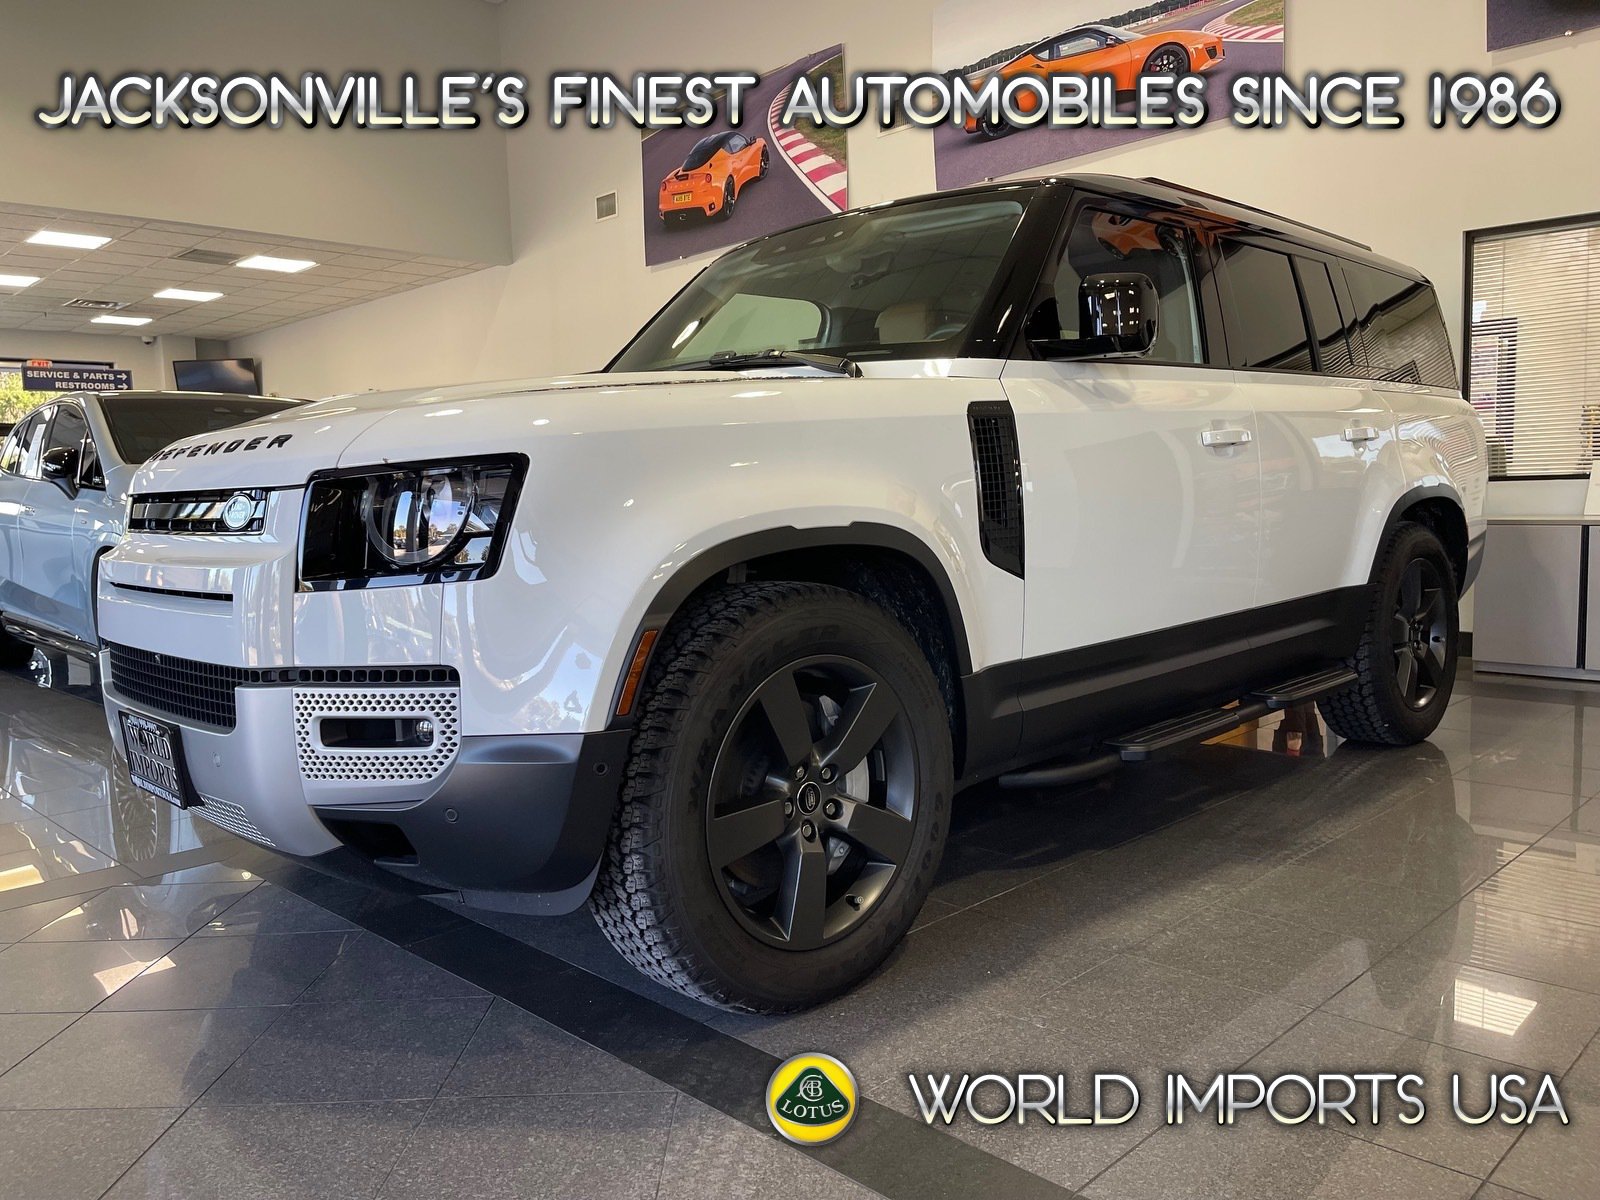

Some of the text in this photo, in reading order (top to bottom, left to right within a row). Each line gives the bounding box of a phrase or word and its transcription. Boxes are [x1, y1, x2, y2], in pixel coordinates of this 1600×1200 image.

[26, 370, 115, 380] SERVICE & PARTS
[55, 381, 116, 390] RESTROOMS
[127, 725, 172, 760] WORLD
[129, 750, 179, 791] IMPORTS
